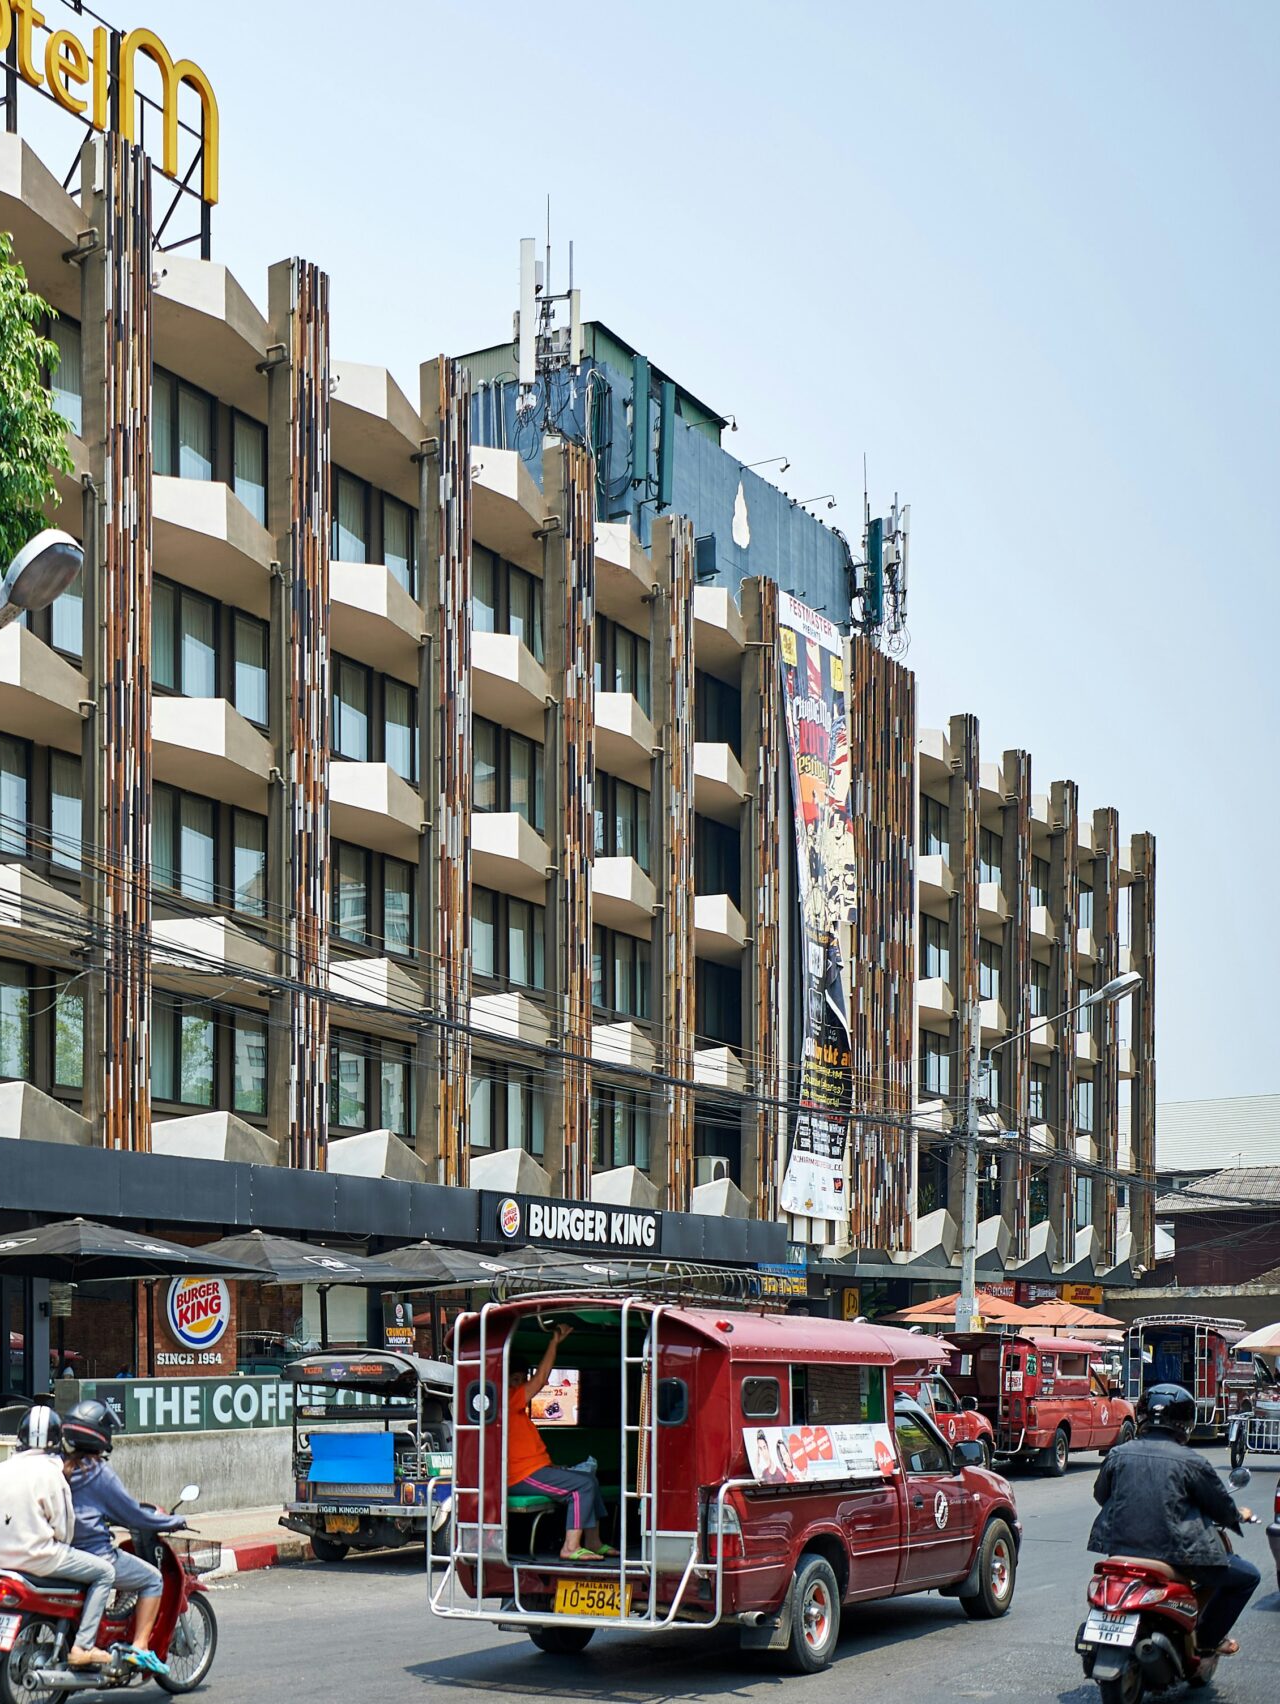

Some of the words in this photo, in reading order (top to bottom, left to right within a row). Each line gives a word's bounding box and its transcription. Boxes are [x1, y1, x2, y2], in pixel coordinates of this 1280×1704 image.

[789, 597, 833, 637] FESTMASTER
[529, 1203, 607, 1244] BURGER
[610, 1212, 656, 1247] KING
[176, 1282, 219, 1309] BURGER
[178, 1295, 222, 1329] KING
[157, 1352, 195, 1365] SINCE
[198, 1352, 222, 1364] 1954
[304, 1366, 323, 1374] TIGER
[349, 1364, 383, 1375] KINGDOM
[133, 1386, 200, 1426] THE
[338, 1506, 369, 1514] KINGDOM
[576, 1582, 615, 1590] THAILAND
